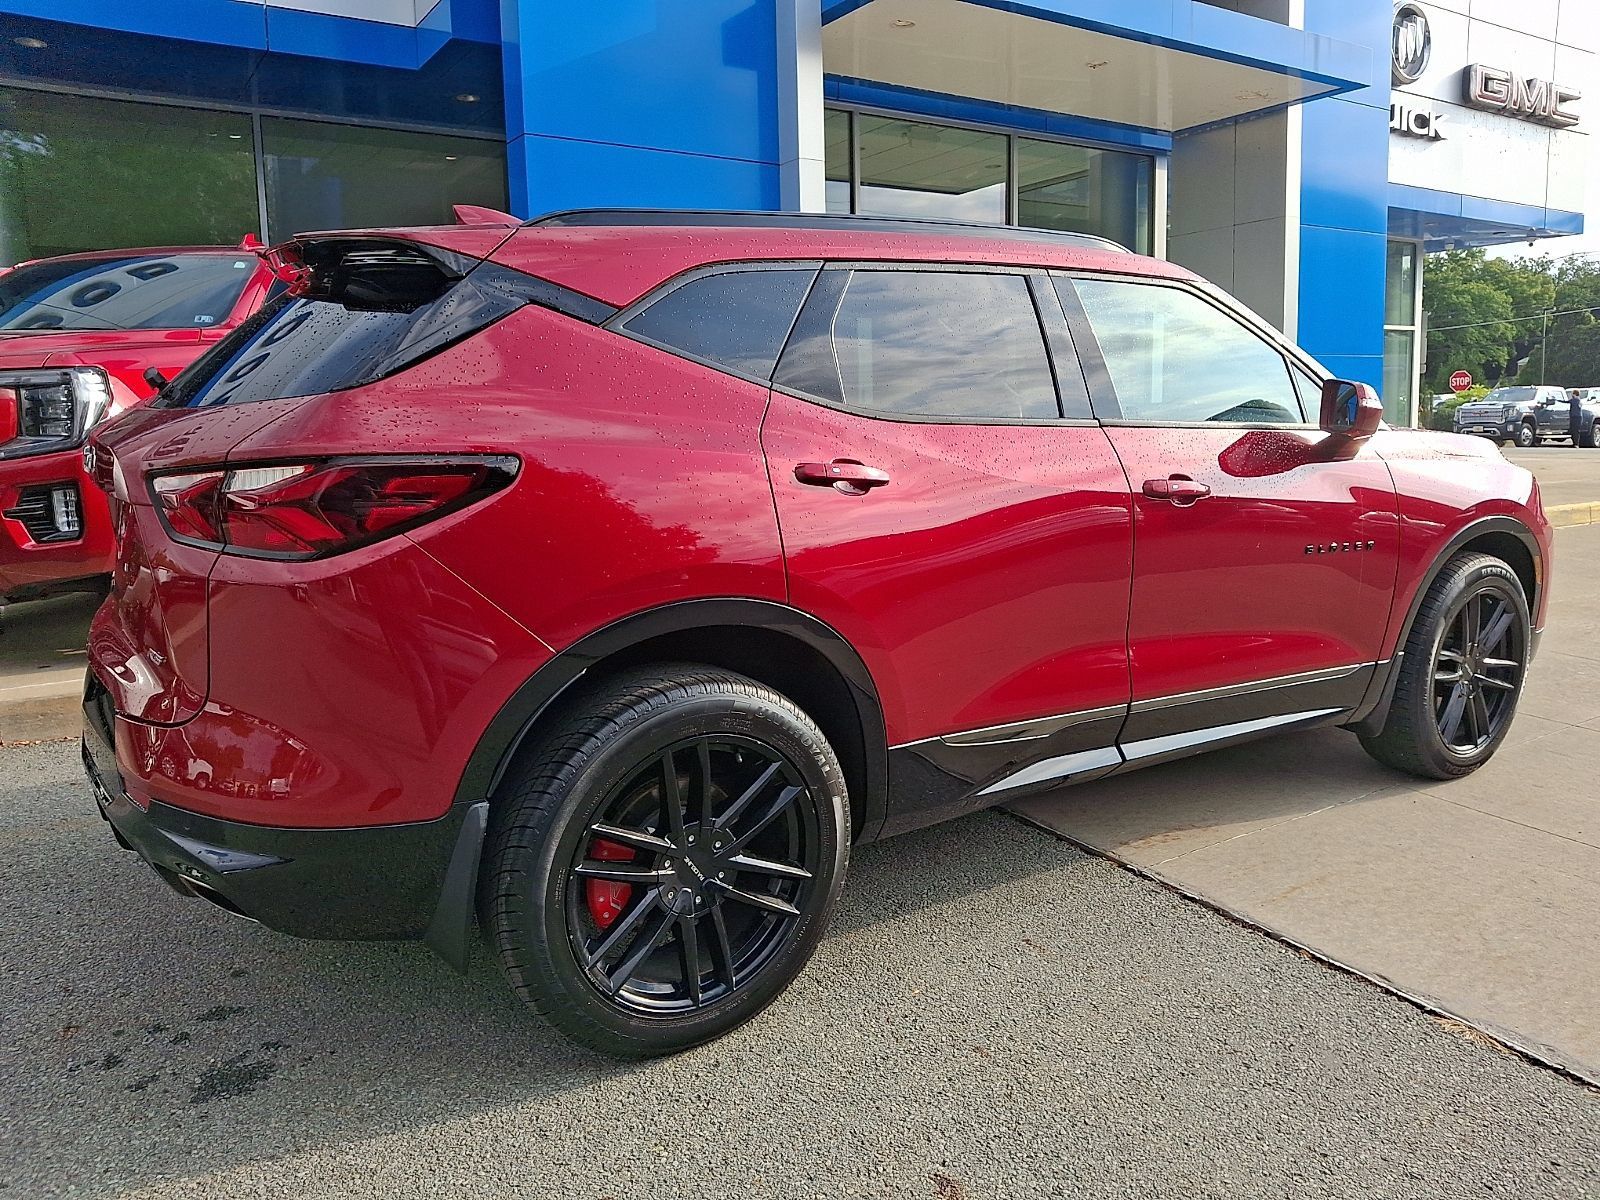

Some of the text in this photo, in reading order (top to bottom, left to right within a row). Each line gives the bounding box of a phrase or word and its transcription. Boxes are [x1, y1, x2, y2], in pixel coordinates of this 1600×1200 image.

[1469, 63, 1581, 125] GMC
[1389, 103, 1447, 138] UICK
[1451, 376, 1470, 387] STOP
[1305, 540, 1375, 555] BLAZER
